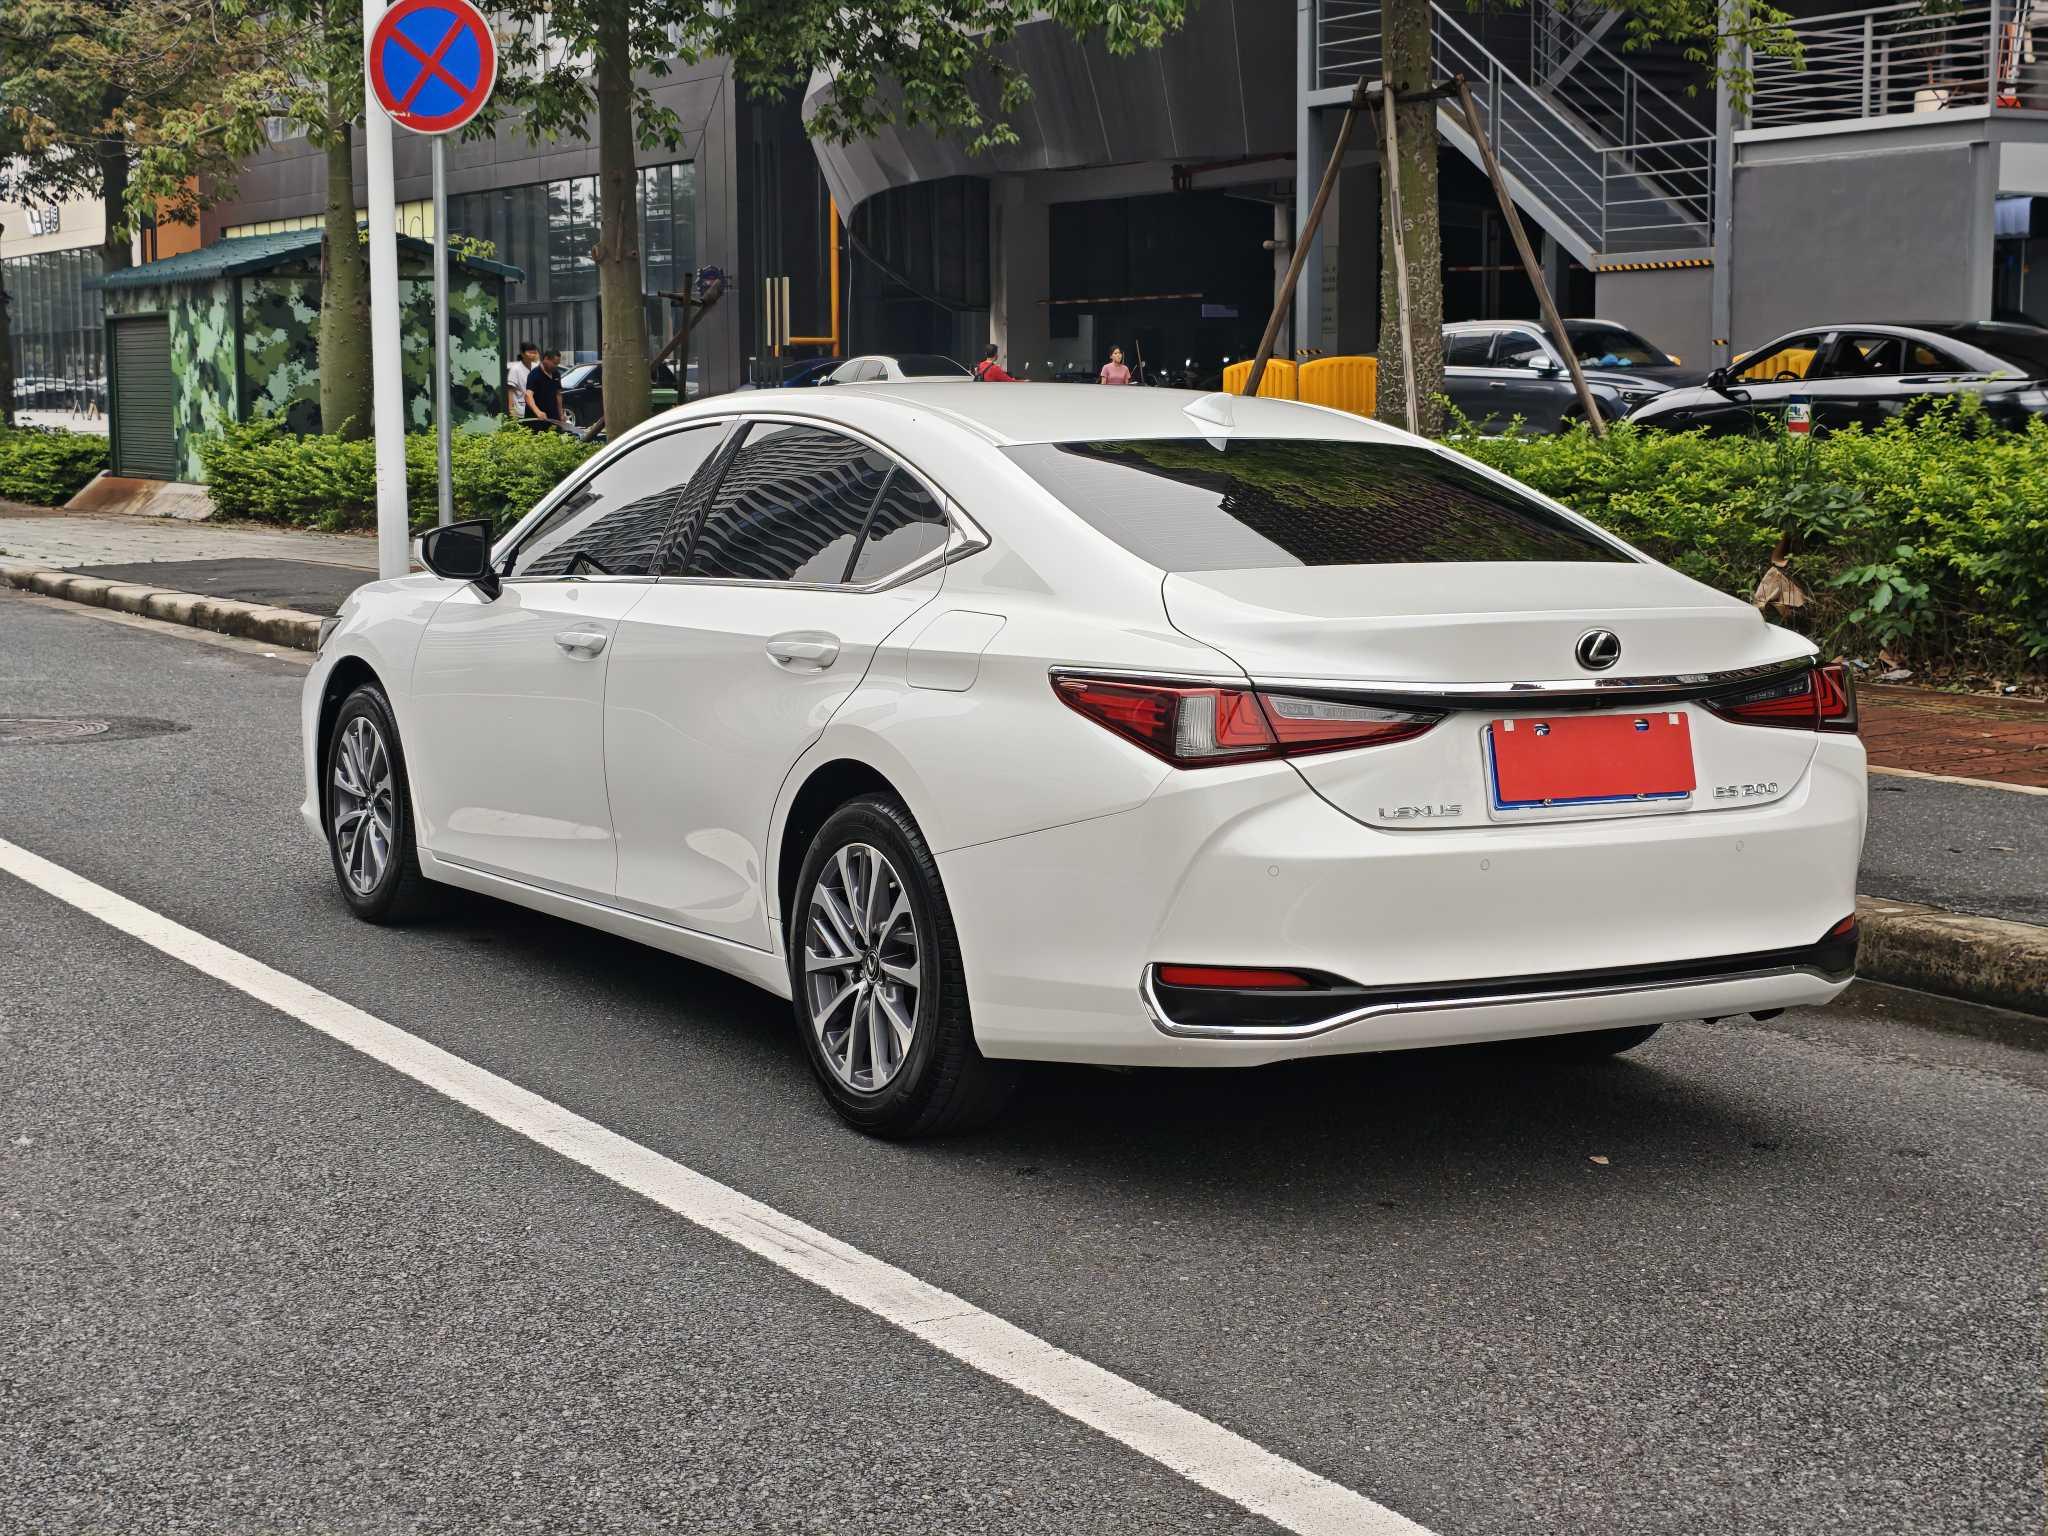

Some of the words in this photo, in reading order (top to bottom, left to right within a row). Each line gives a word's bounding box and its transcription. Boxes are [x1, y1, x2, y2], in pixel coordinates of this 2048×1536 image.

[1712, 785, 1739, 800] ES
[1741, 782, 1779, 798] 200
[1378, 803, 1464, 821] LEXUS
